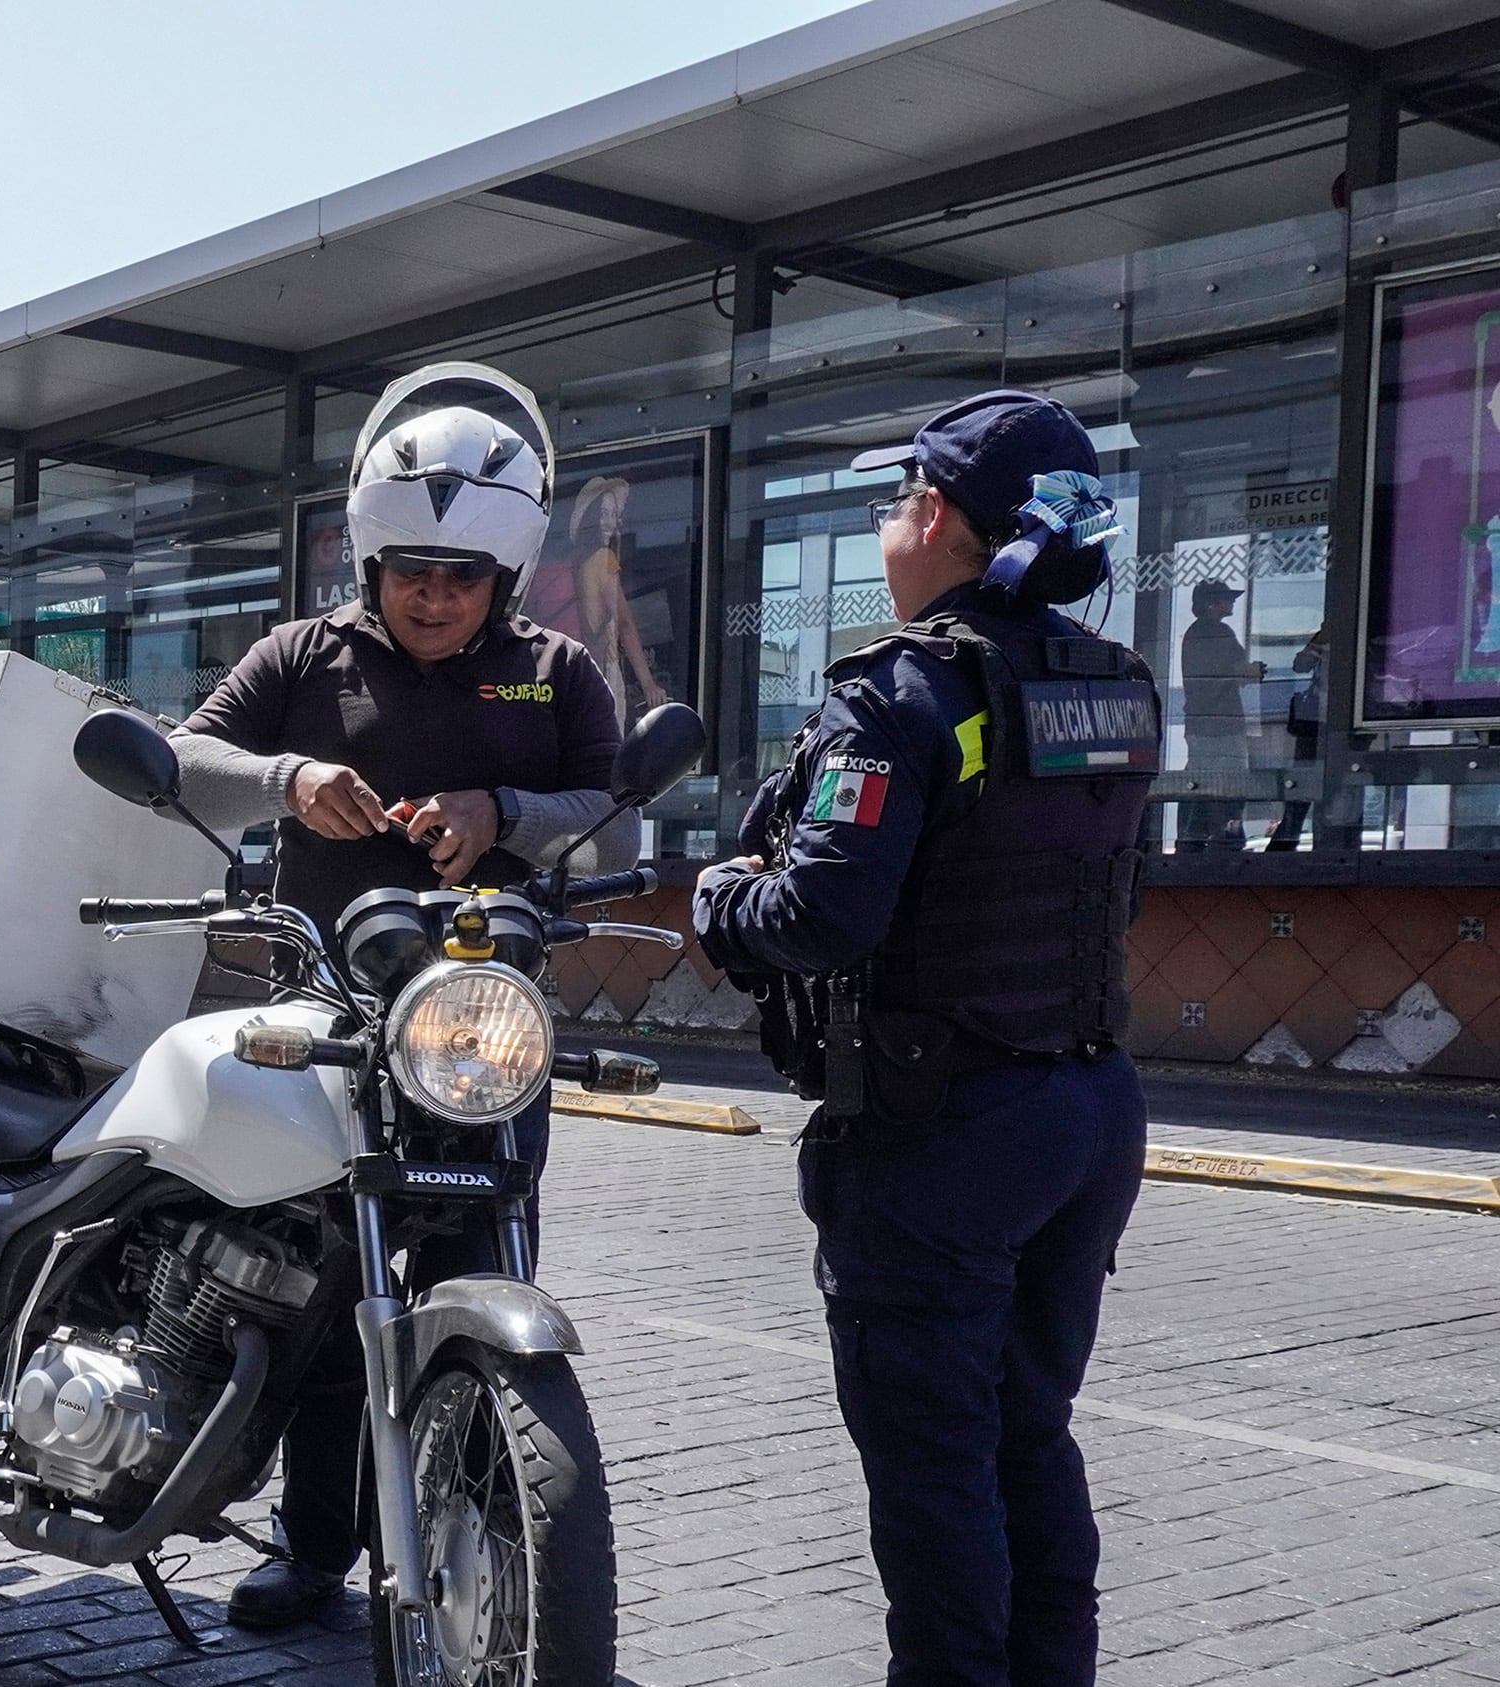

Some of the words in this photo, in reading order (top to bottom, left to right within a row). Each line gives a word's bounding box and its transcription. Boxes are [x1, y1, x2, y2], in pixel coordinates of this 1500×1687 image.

[1266, 516, 1285, 528] DE
[1289, 515, 1307, 525] LA
[315, 582, 357, 609] LAS
[496, 683, 554, 703] BUFALO
[1029, 687, 1095, 745] POLICÍA
[825, 753, 890, 775] MÉXICO
[555, 1094, 595, 1107] PUEBLA
[405, 1170, 494, 1187] HONDA
[57, 1397, 86, 1413] HONDA
